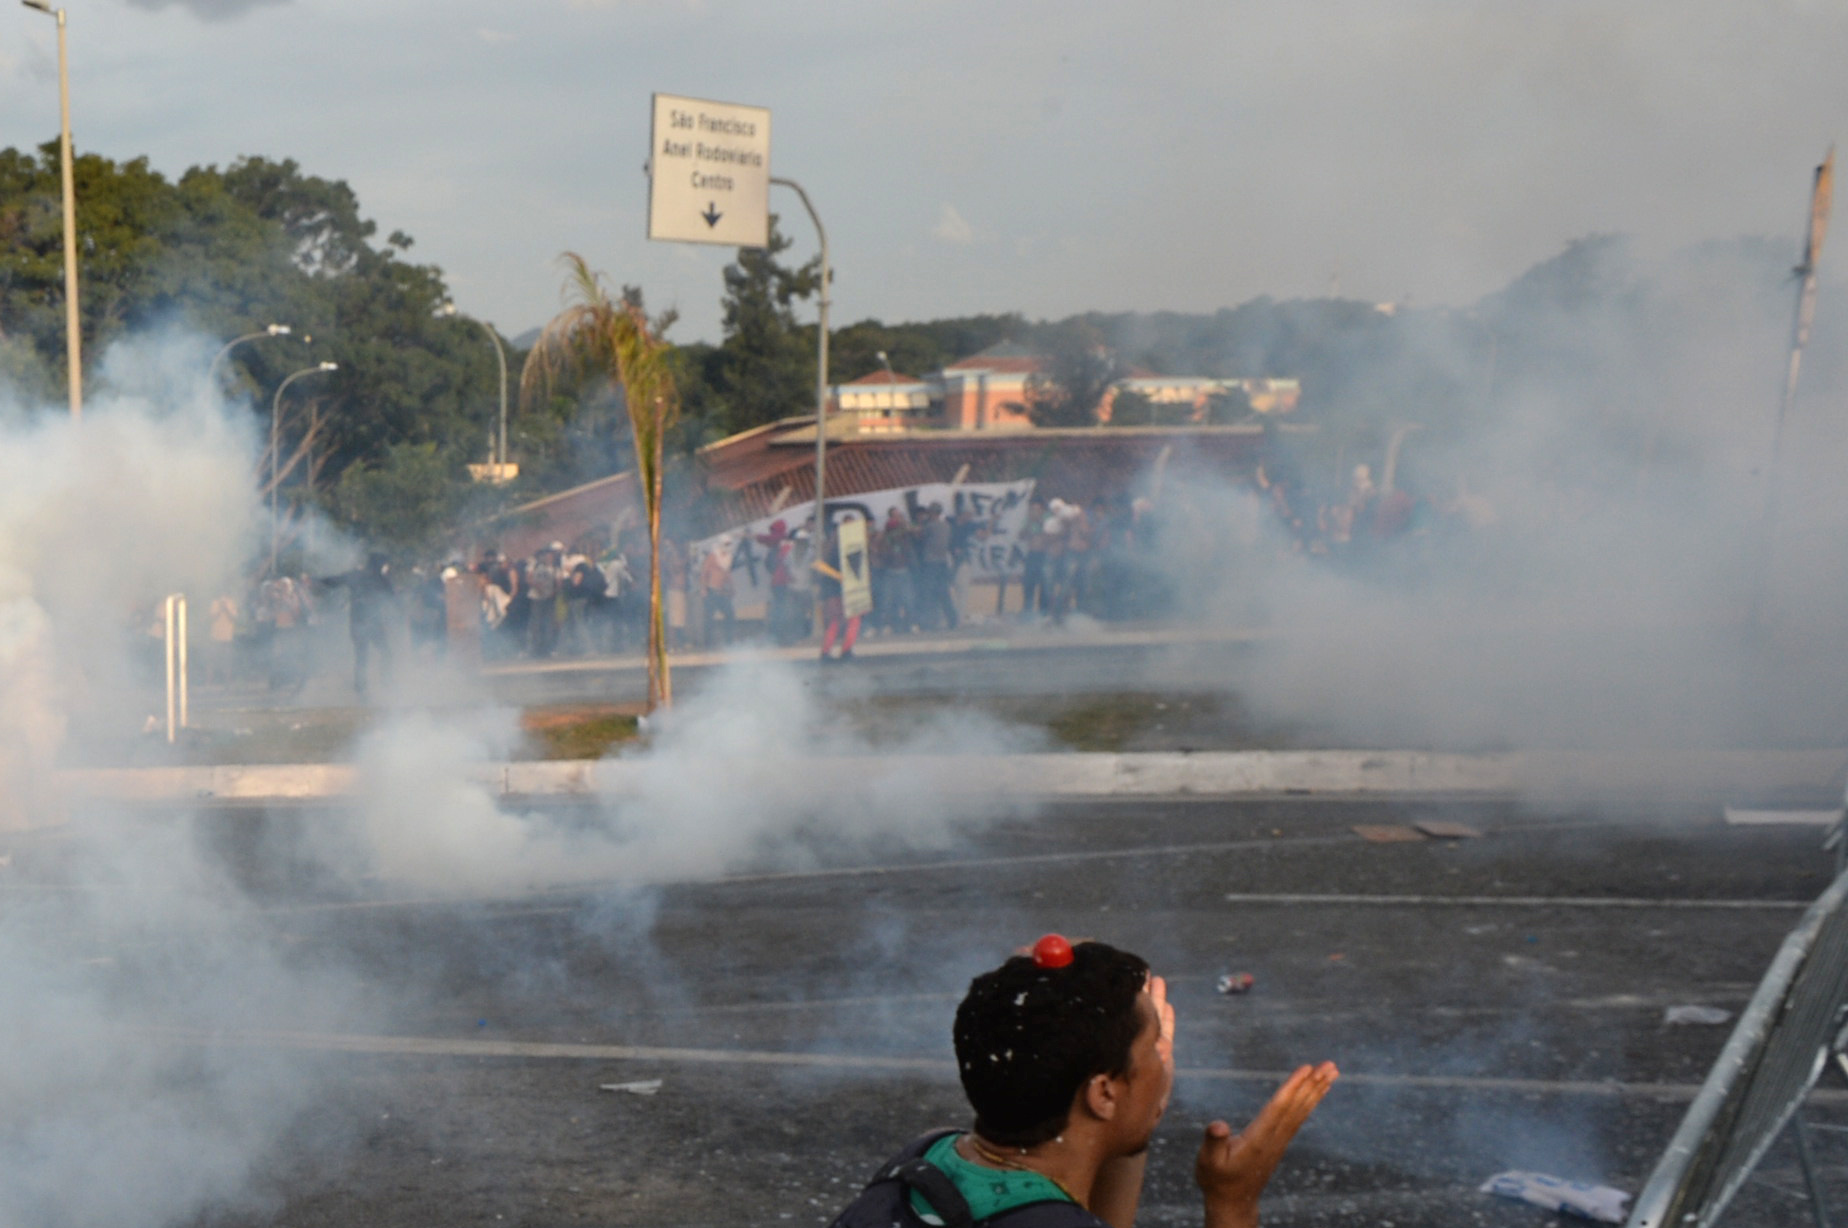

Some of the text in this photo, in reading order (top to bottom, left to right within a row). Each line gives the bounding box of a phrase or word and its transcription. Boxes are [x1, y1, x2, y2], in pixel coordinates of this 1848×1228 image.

[670, 109, 756, 138] São Francisco
[663, 138, 692, 158] Anel
[690, 170, 735, 192] Centro
